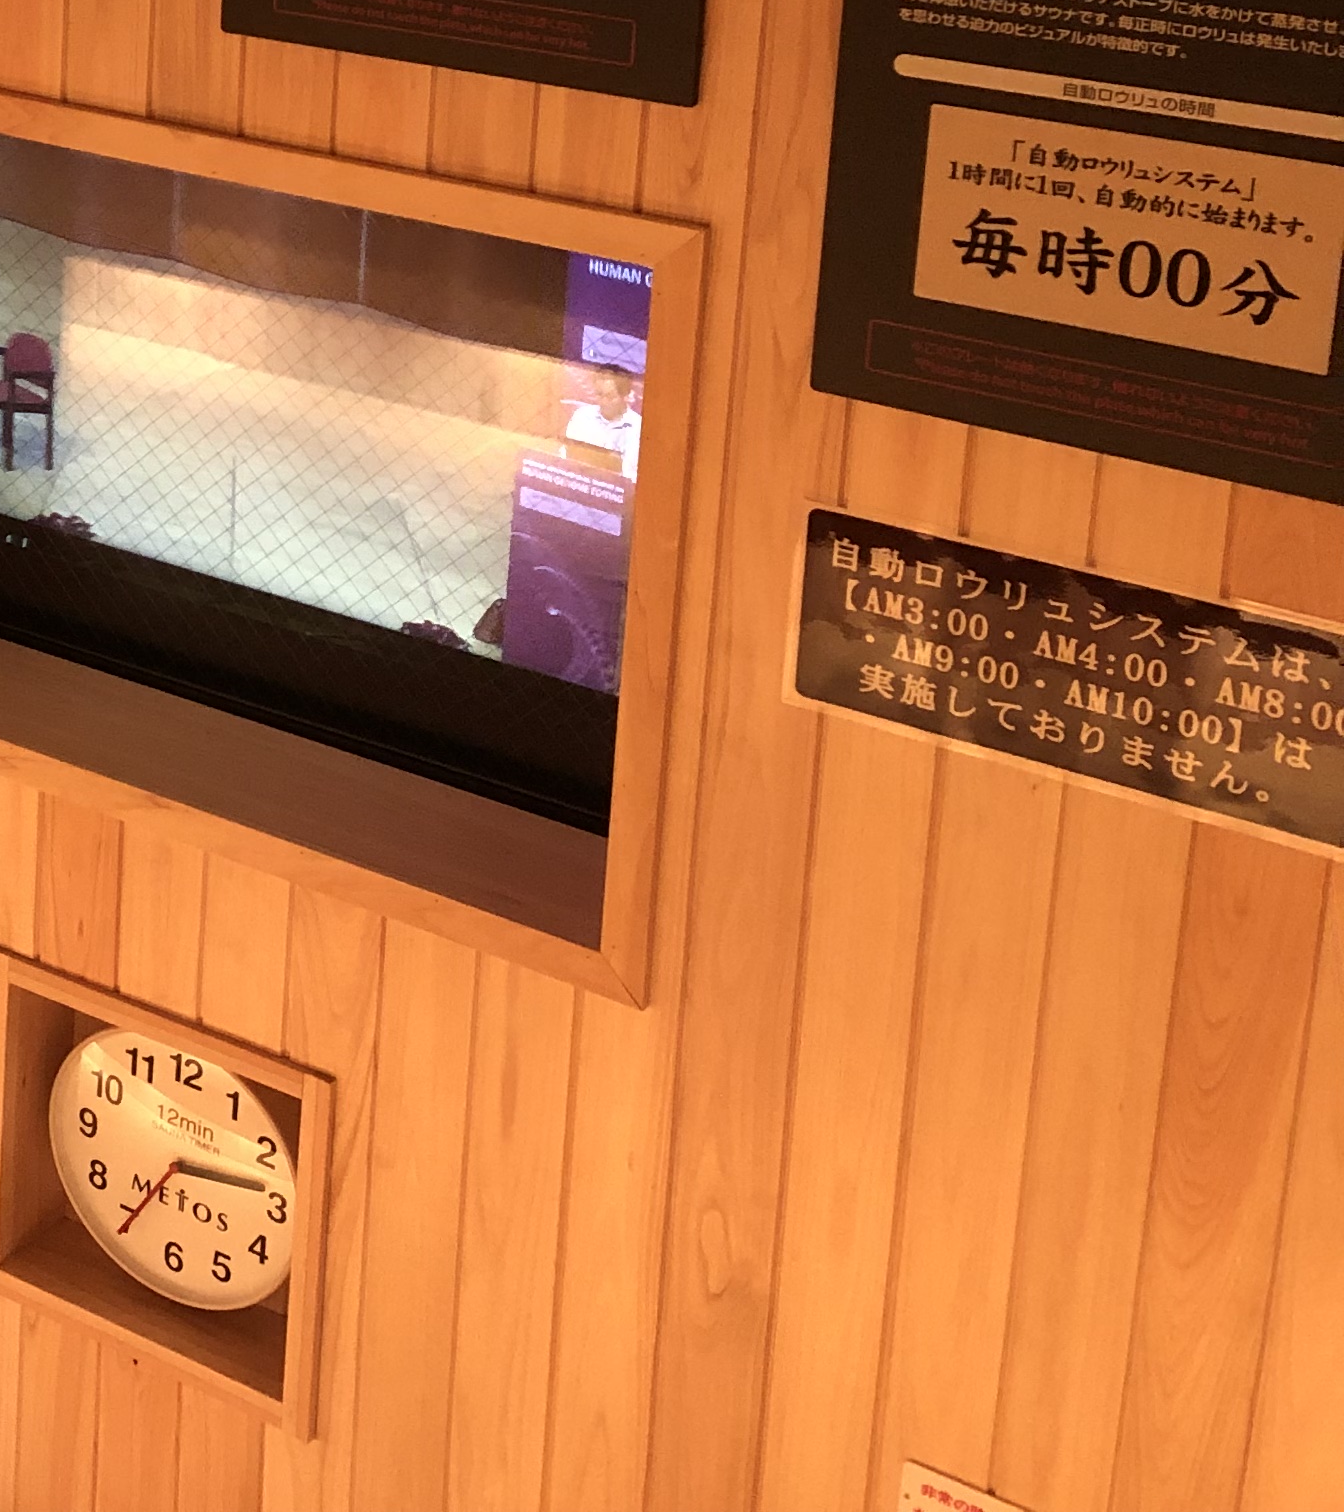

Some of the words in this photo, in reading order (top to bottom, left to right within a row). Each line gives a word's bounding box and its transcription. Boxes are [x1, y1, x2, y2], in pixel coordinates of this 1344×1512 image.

[1063, 82, 1216, 119] 自動ロウリュの時間
[1011, 139, 1259, 202] 「自動ロウリュシステム」
[948, 160, 1314, 243] 1時間に1回、自動的に始まります。
[589, 258, 642, 285] HUMAN
[952, 207, 1302, 326] 毎時00分
[830, 537, 1332, 691] 自動ロウリュシステムは、
[859, 663, 1271, 804] 実施しておりません。
[125, 1047, 155, 1084] 11
[170, 1053, 203, 1091] 12
[91, 1069, 123, 1105] 10
[79, 1107, 98, 1138] 9
[157, 1104, 214, 1142] 12min
[226, 1091, 240, 1121] 1
[256, 1136, 277, 1170] 2
[88, 1159, 107, 1190] 8
[132, 1173, 229, 1232] METOS
[266, 1192, 287, 1224] 3
[164, 1241, 184, 1273] 6
[212, 1250, 231, 1283] 5
[247, 1234, 269, 1265] 4
